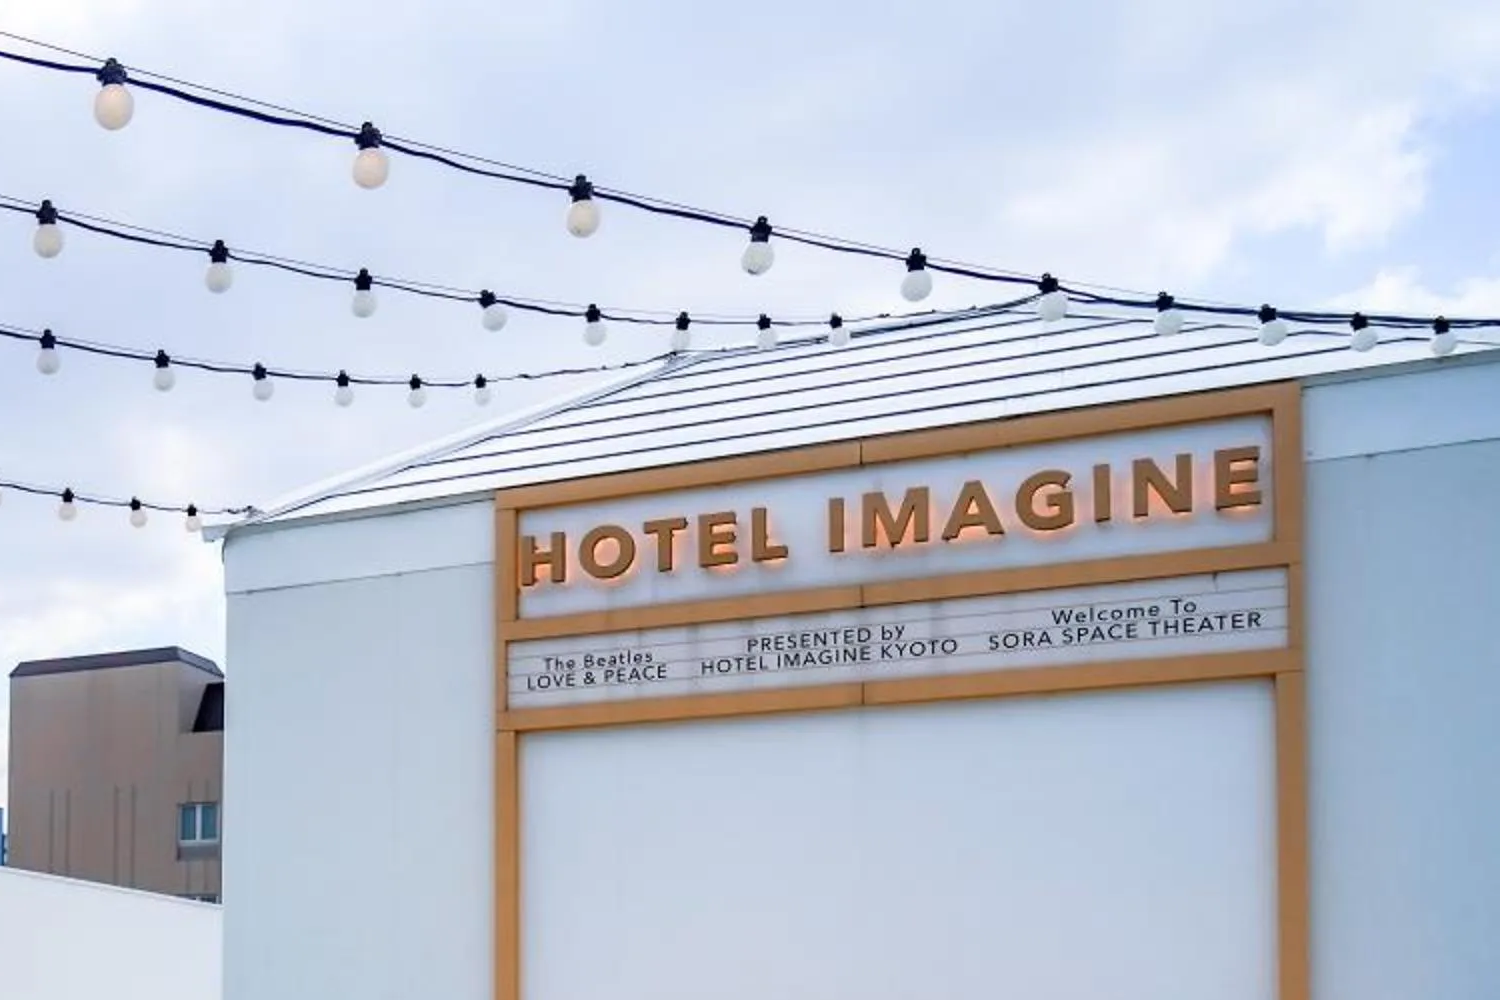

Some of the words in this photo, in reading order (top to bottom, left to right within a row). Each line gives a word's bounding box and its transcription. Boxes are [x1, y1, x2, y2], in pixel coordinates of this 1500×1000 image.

[521, 506, 790, 586] HOTEL
[828, 445, 1263, 553] IMAGINE
[1051, 604, 1161, 625] Welcome
[1169, 598, 1198, 616] To
[747, 626, 872, 653] PRESENTED
[880, 624, 906, 642] by
[989, 630, 1053, 651] SORA
[1061, 622, 1139, 645] SPACE
[1147, 612, 1263, 637] THEATER
[543, 656, 577, 672] The
[583, 649, 654, 670] Beatles
[700, 655, 769, 676] HOTEL
[776, 645, 872, 669] IMAGINE
[880, 638, 959, 660] KYOTO
[526, 674, 577, 692] LOVE
[583, 671, 597, 686] &
[603, 664, 668, 684] PEACE
